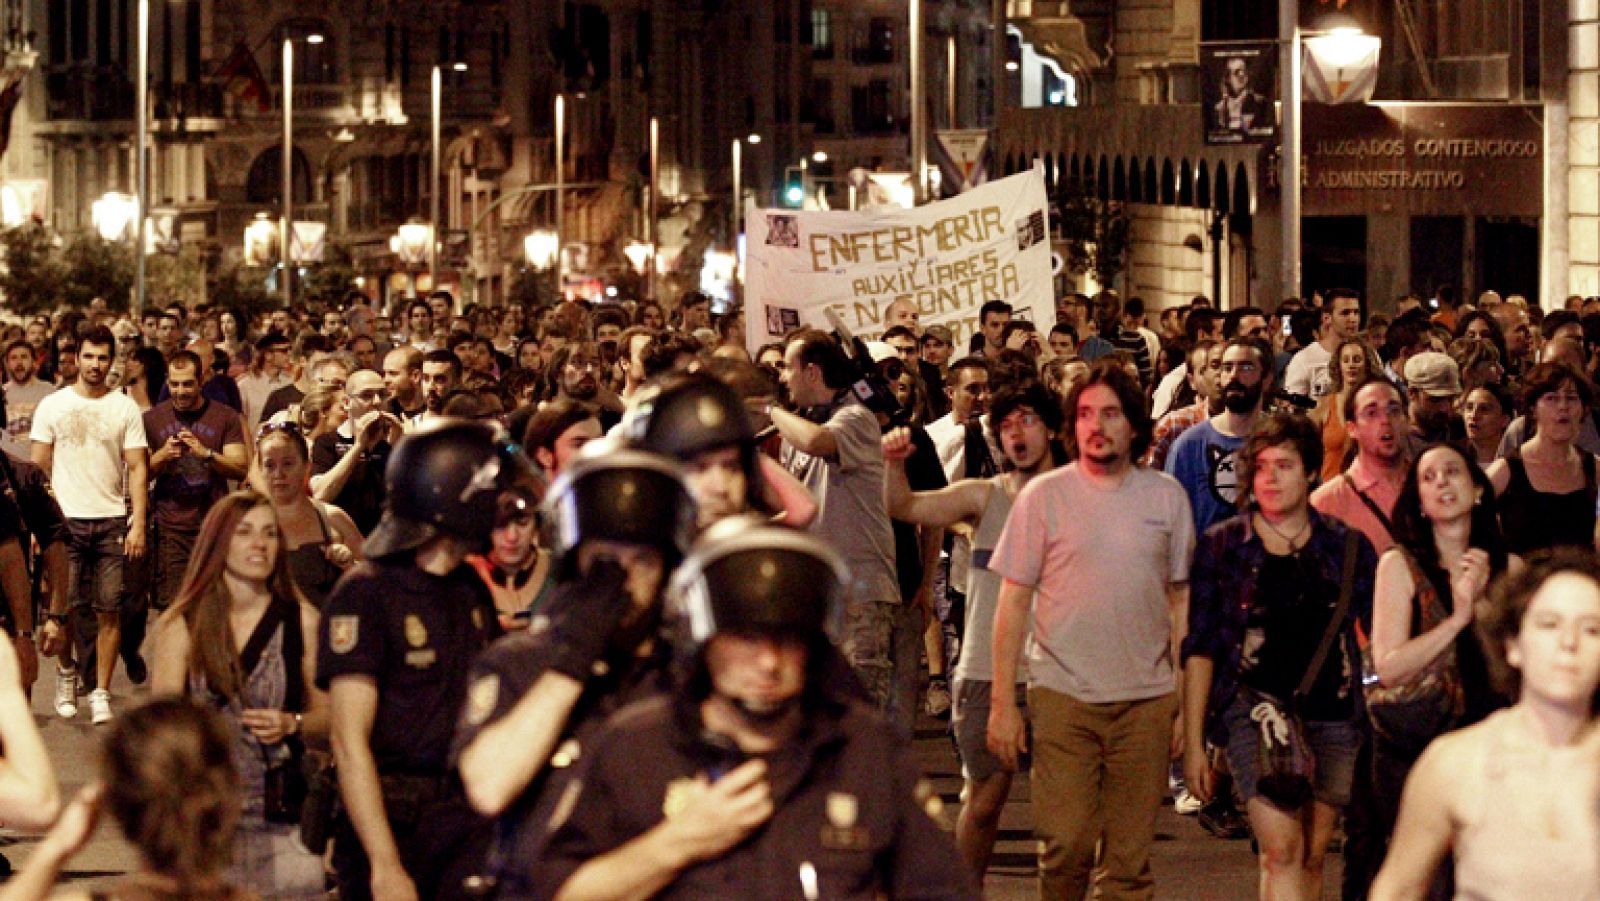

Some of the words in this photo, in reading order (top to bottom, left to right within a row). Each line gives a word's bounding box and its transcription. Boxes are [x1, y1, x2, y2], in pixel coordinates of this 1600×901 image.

[1315, 139, 1405, 156] JUZGADOS
[1414, 138, 1538, 157] CONTENCIOSO
[1317, 170, 1465, 189] ADMINISTRATIVO
[809, 205, 1004, 272] ENFERMERIA
[852, 249, 998, 297] AUXILIARES
[895, 261, 1019, 316] ONTRA
